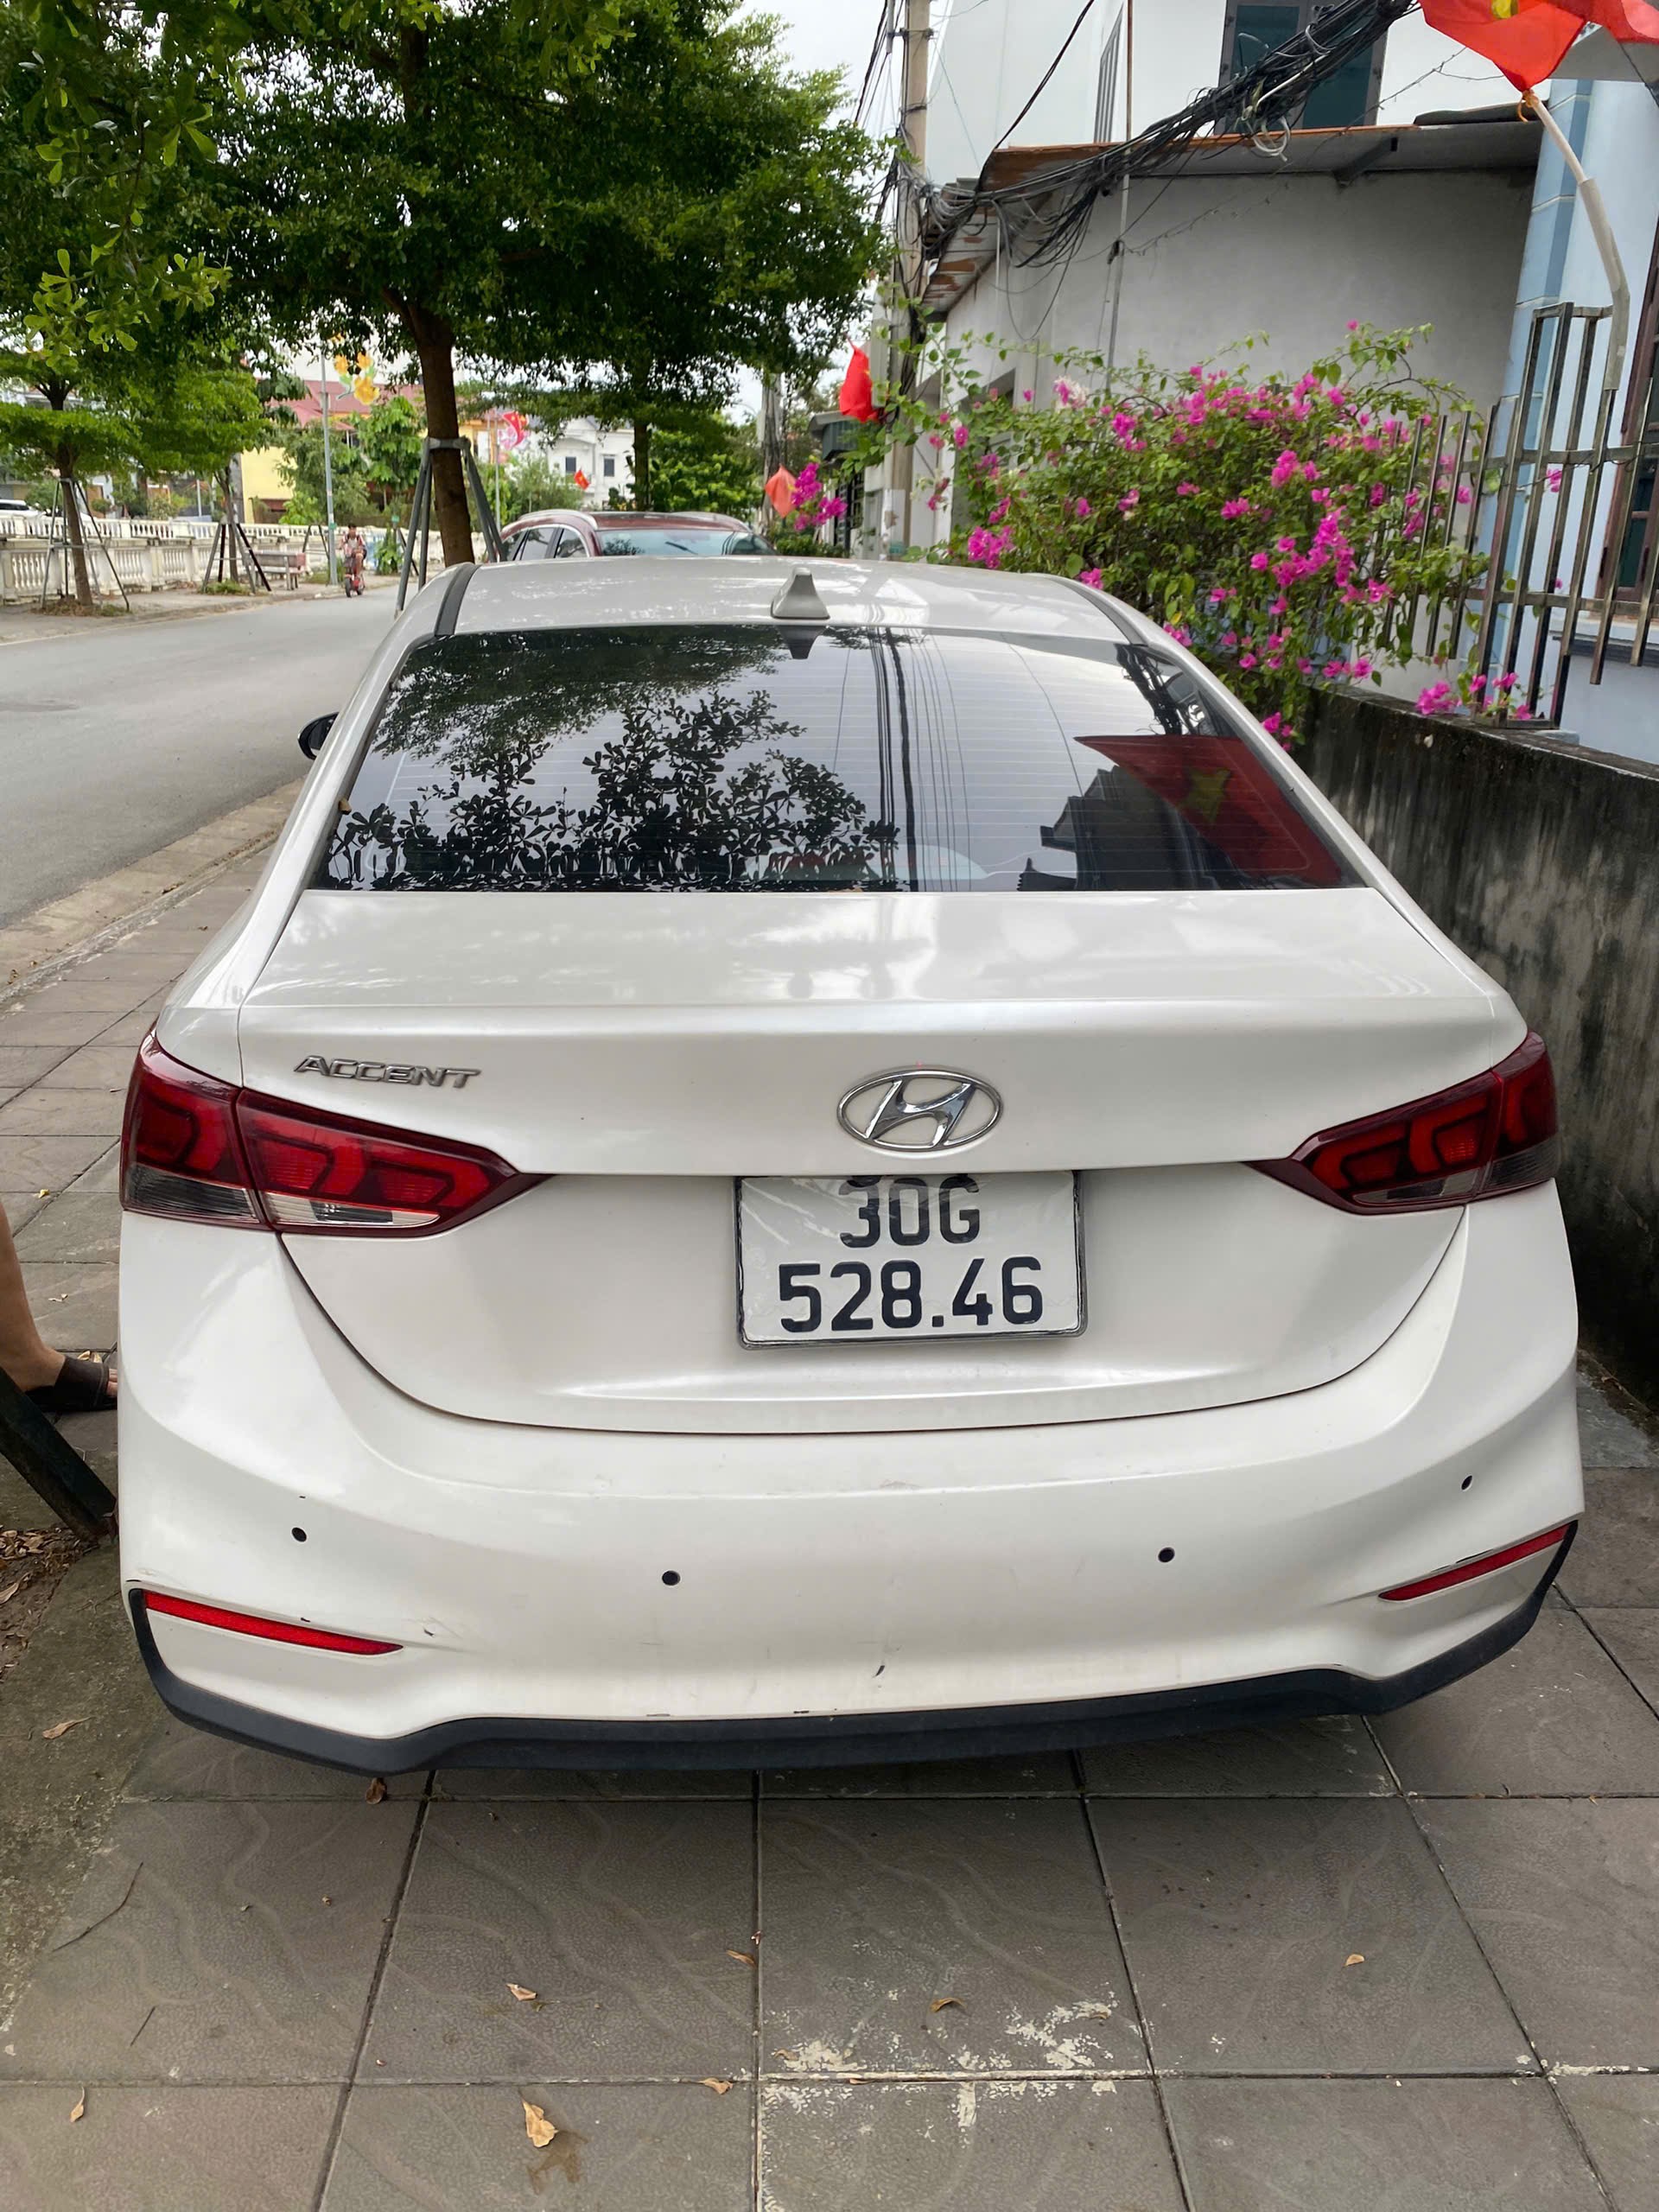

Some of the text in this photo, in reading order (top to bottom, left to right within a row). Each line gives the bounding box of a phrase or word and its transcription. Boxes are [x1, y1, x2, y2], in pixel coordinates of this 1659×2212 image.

[294, 1054, 481, 1089] ACCENT
[838, 1177, 981, 1248] 30G
[779, 1256, 1044, 1332] 528.46
